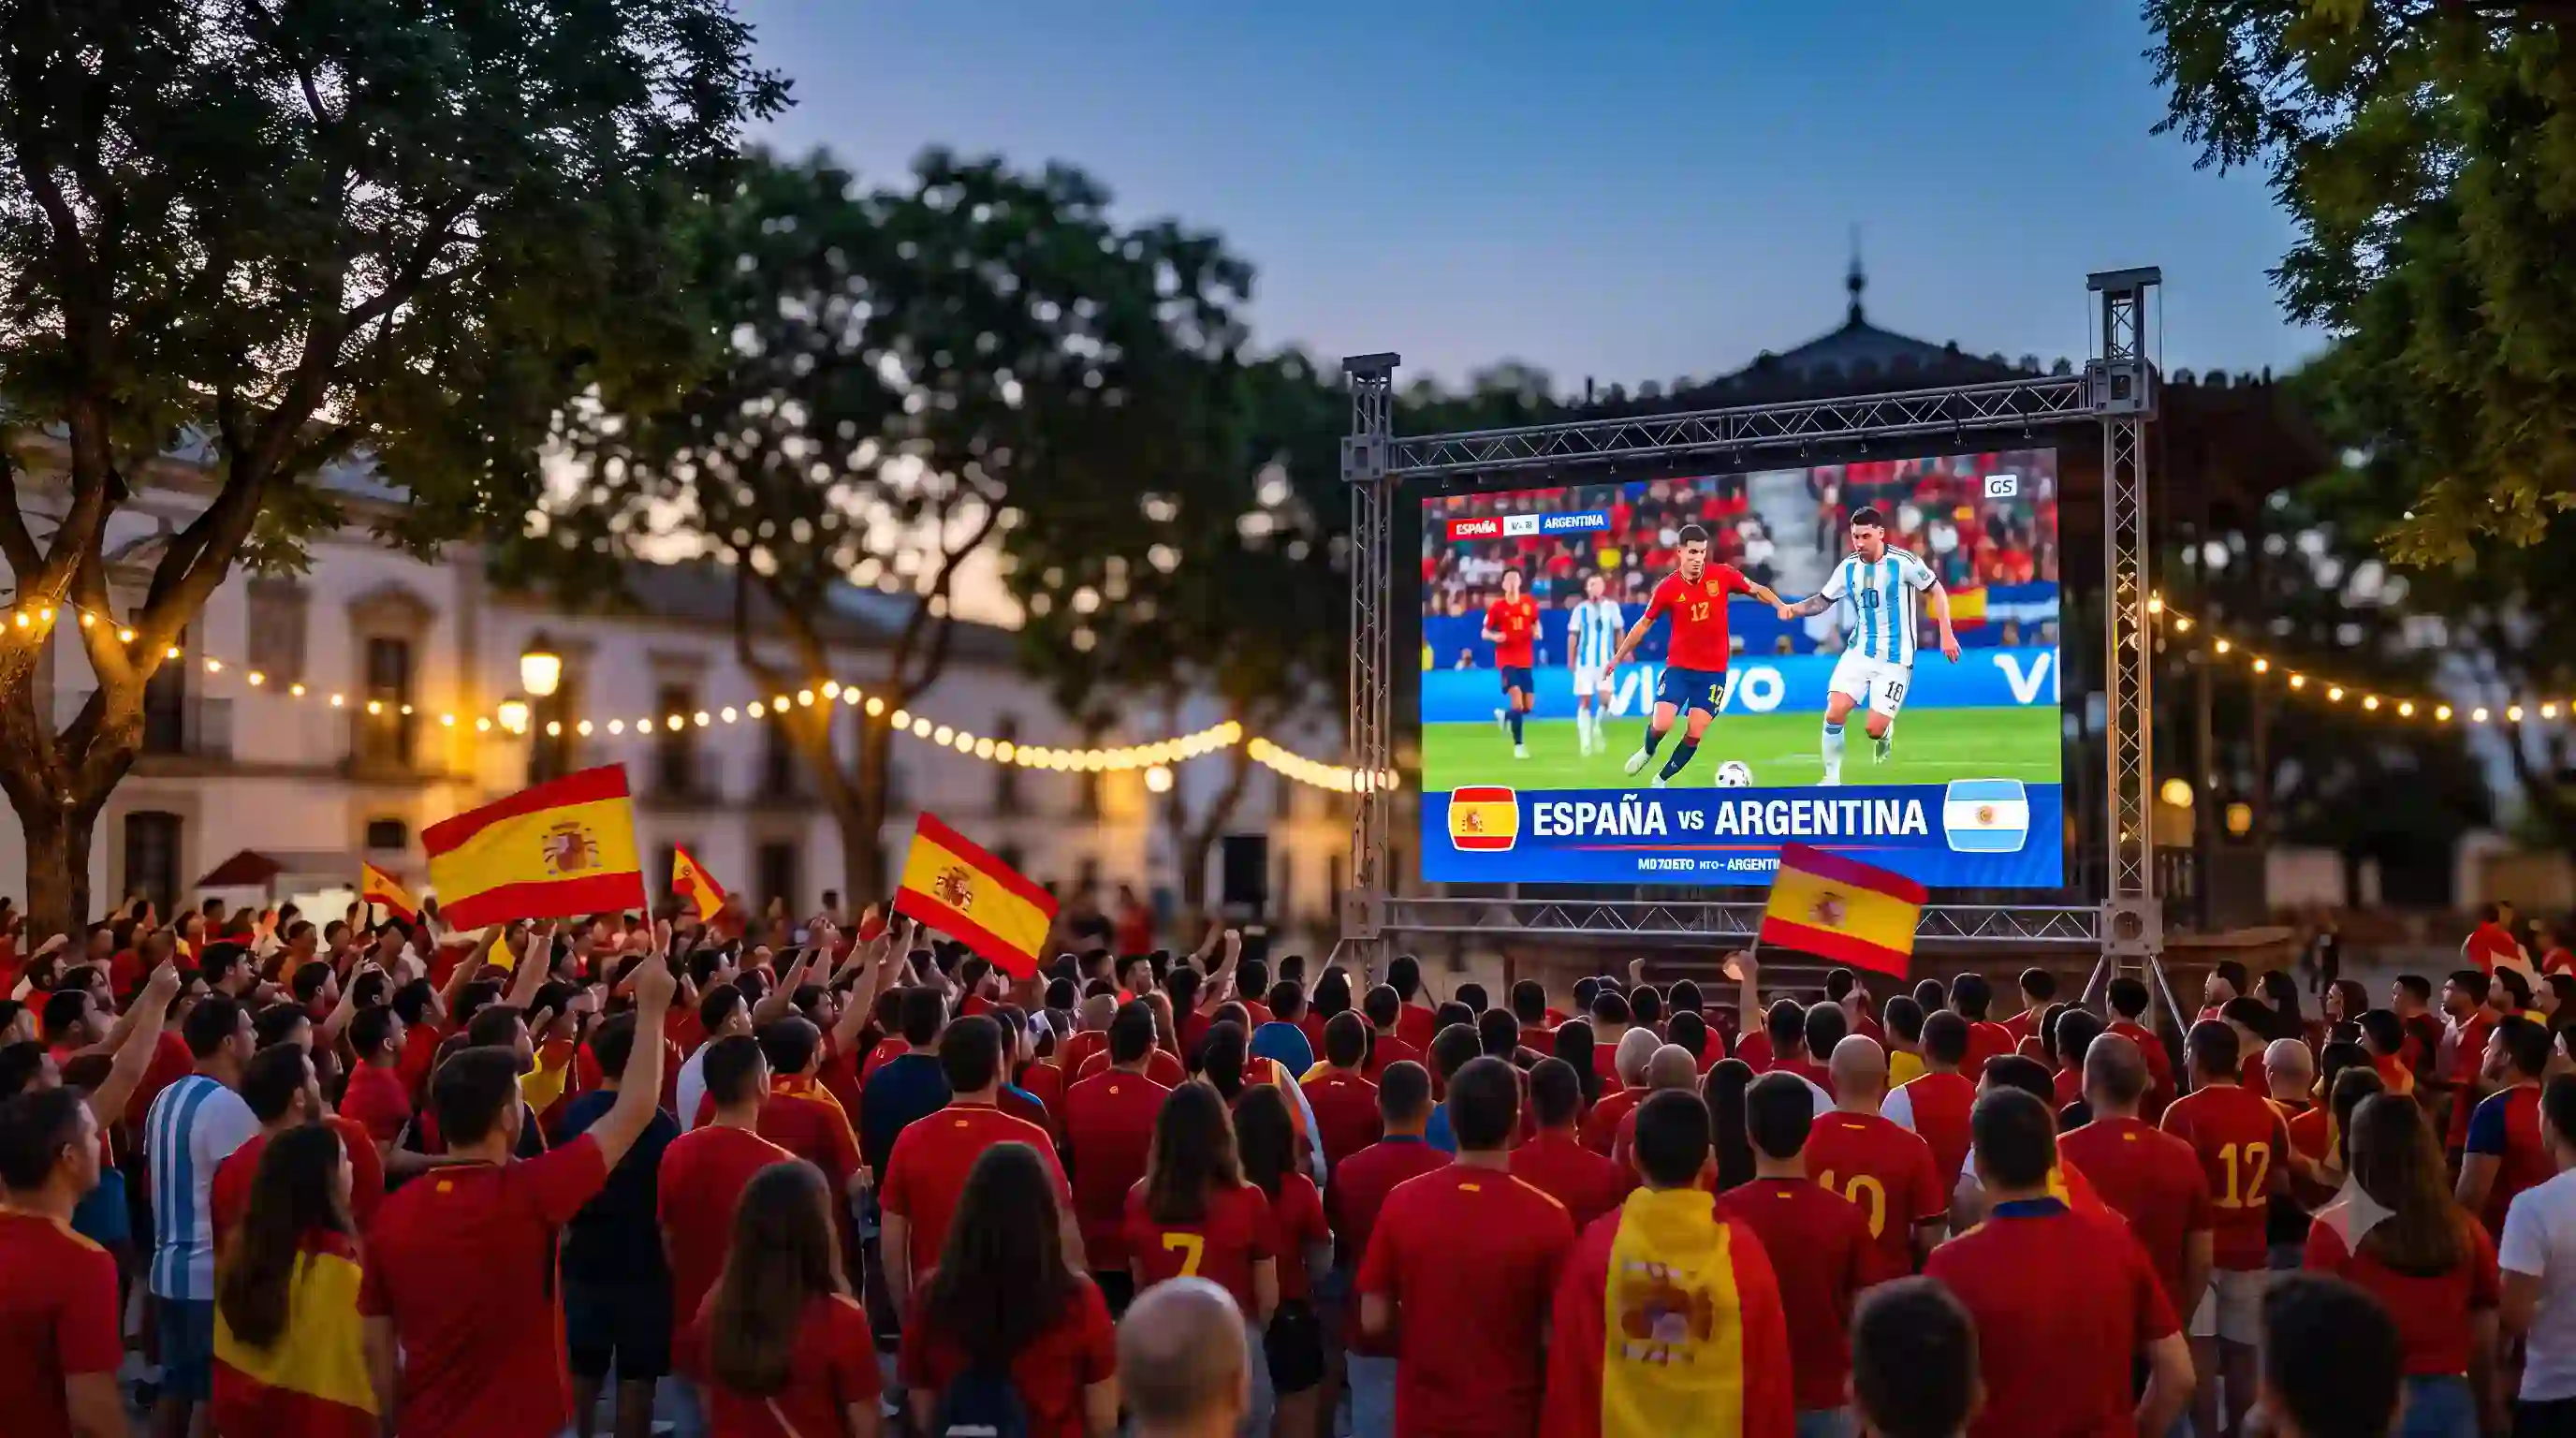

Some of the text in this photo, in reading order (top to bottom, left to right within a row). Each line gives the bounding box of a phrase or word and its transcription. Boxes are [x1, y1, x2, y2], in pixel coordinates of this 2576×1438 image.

[1990, 479, 2013, 494] GS
[1456, 521, 1497, 536] ESPAÑA
[1544, 515, 1604, 529] ARGENTINA
[1690, 601, 1710, 623] 12
[1533, 793, 1668, 836] ESPAÑA
[1714, 799, 1928, 836] ARGENTINA
[2213, 1142, 2270, 1208] 12
[1162, 1232, 1205, 1278] 7
